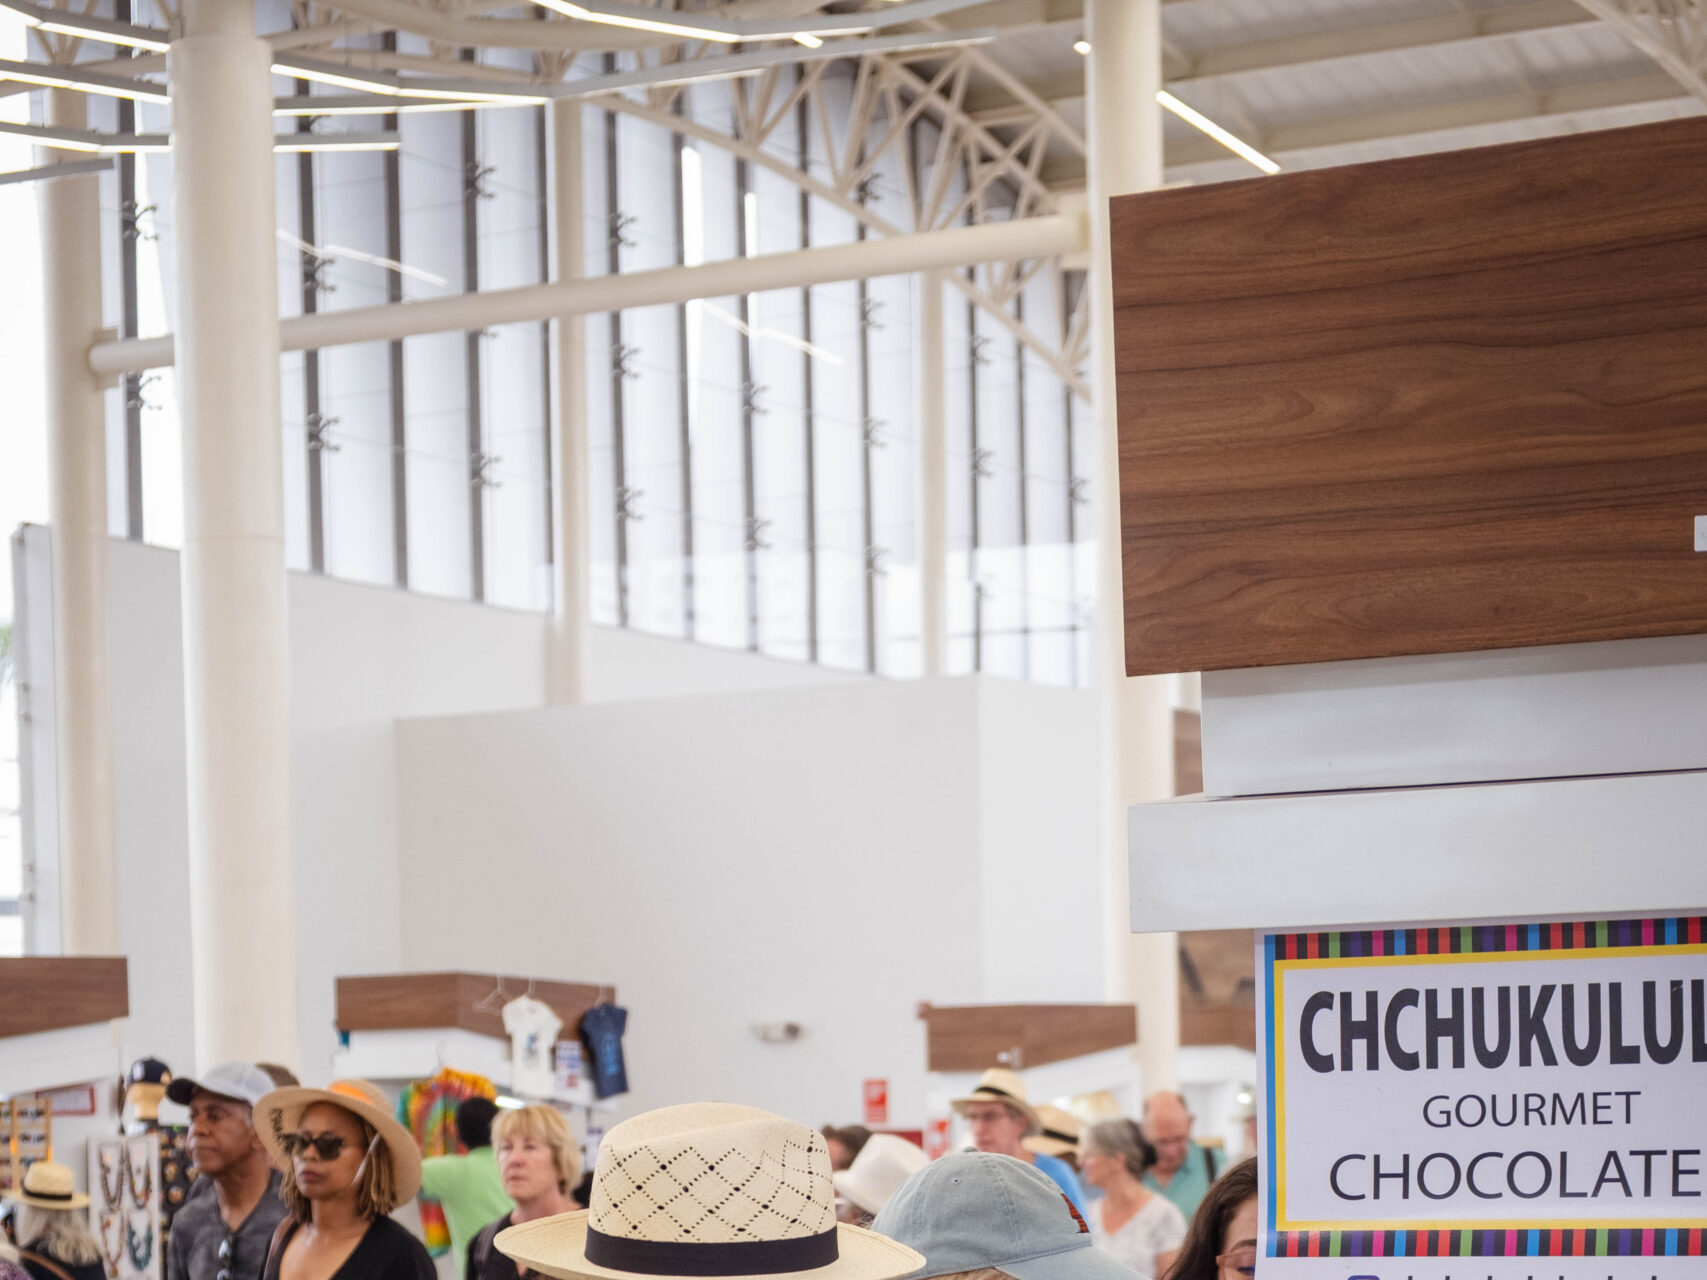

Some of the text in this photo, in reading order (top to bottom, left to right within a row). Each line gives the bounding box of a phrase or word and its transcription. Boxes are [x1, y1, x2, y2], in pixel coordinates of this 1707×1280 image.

[1300, 978, 1707, 1073] CHCHUKULUL
[1422, 1091, 1641, 1128] GOURMET
[1329, 1149, 1702, 1200] CHOCOLATE
